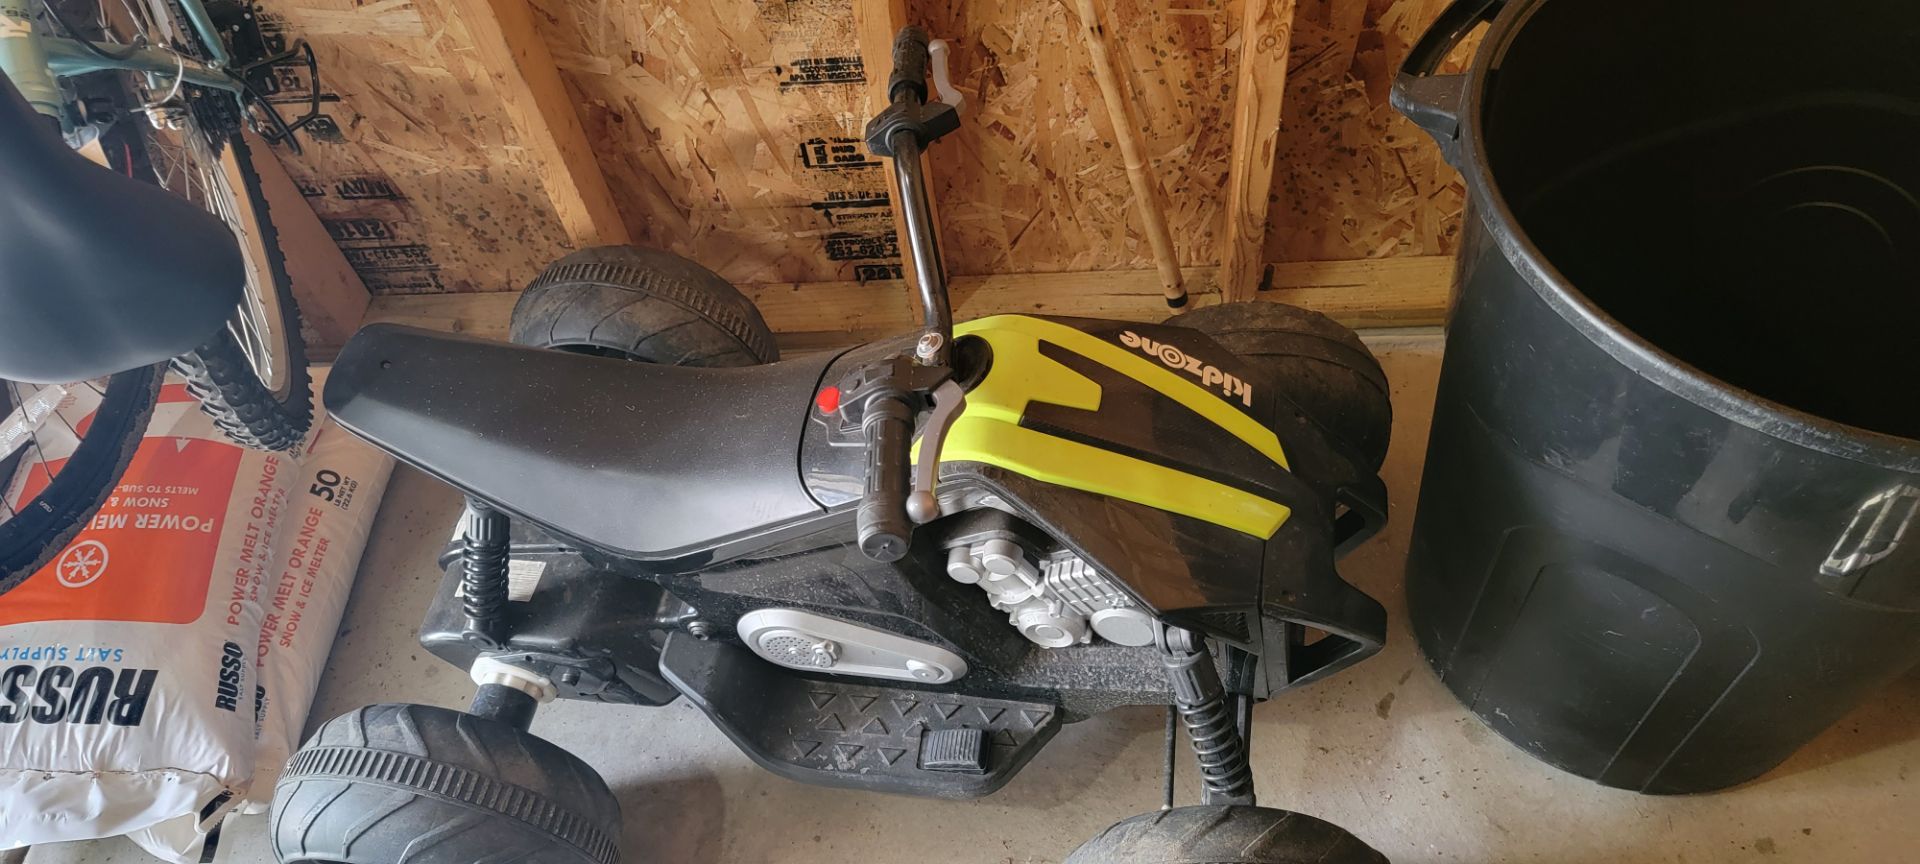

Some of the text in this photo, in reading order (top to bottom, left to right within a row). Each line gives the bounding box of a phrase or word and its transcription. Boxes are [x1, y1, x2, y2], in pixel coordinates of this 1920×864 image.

[1119, 330, 1251, 407] kidzone
[110, 496, 170, 508] SNOW &
[146, 484, 162, 494] TO
[165, 485, 200, 496] MELTS
[308, 469, 341, 502] 50
[82, 513, 215, 533] POWER MEL
[227, 455, 279, 625] POWER MELT ORANGE
[249, 563, 265, 602] SNOW
[261, 530, 273, 549] ICE
[272, 571, 297, 610] MELT
[288, 506, 323, 569] ORANGE
[279, 537, 331, 648] SNOW & ICE MELTER
[76, 647, 124, 663] SALT
[215, 641, 243, 713] RUSSO
[0, 665, 159, 727] RUSS
[257, 697, 270, 722] SUPPLY
